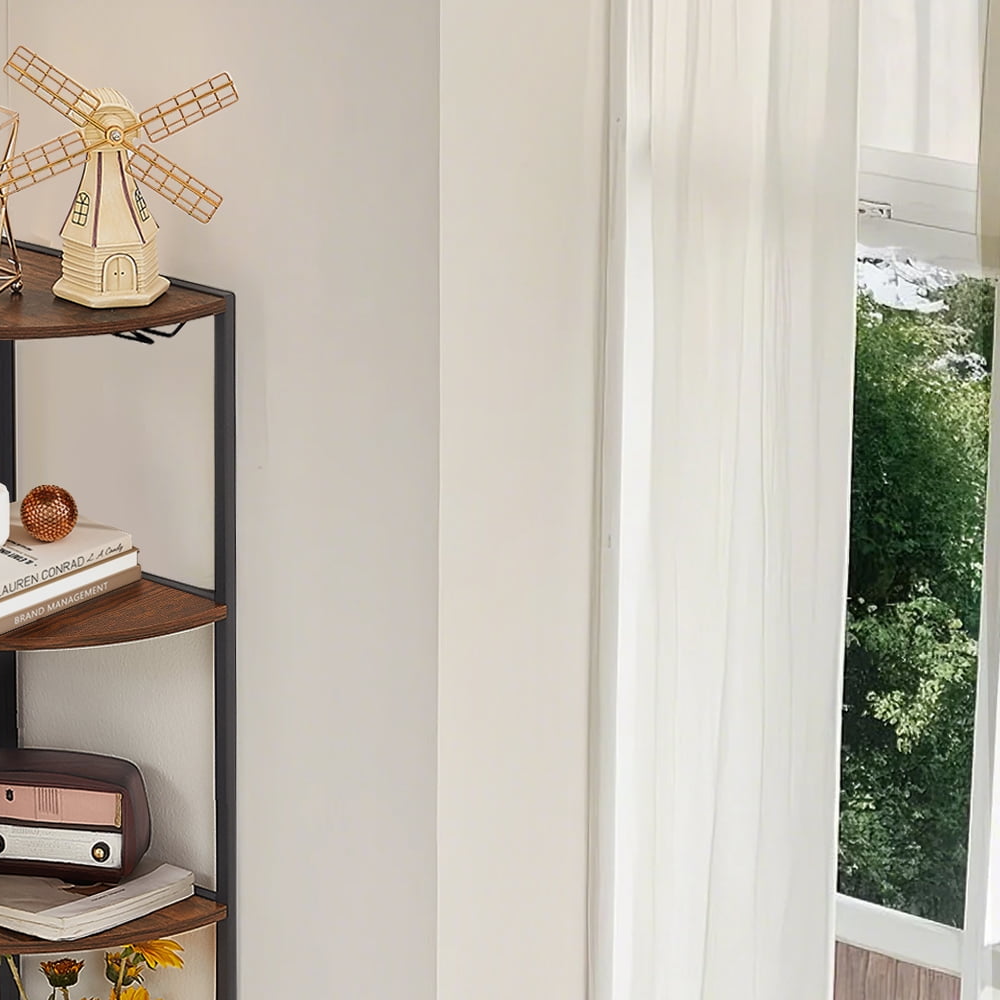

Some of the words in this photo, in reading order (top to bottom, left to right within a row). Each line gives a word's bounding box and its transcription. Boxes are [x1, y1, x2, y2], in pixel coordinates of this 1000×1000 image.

[41, 556, 85, 580] CONRAD
[14, 606, 46, 625] BRAND
[47, 581, 109, 612] MANAGEMENT
